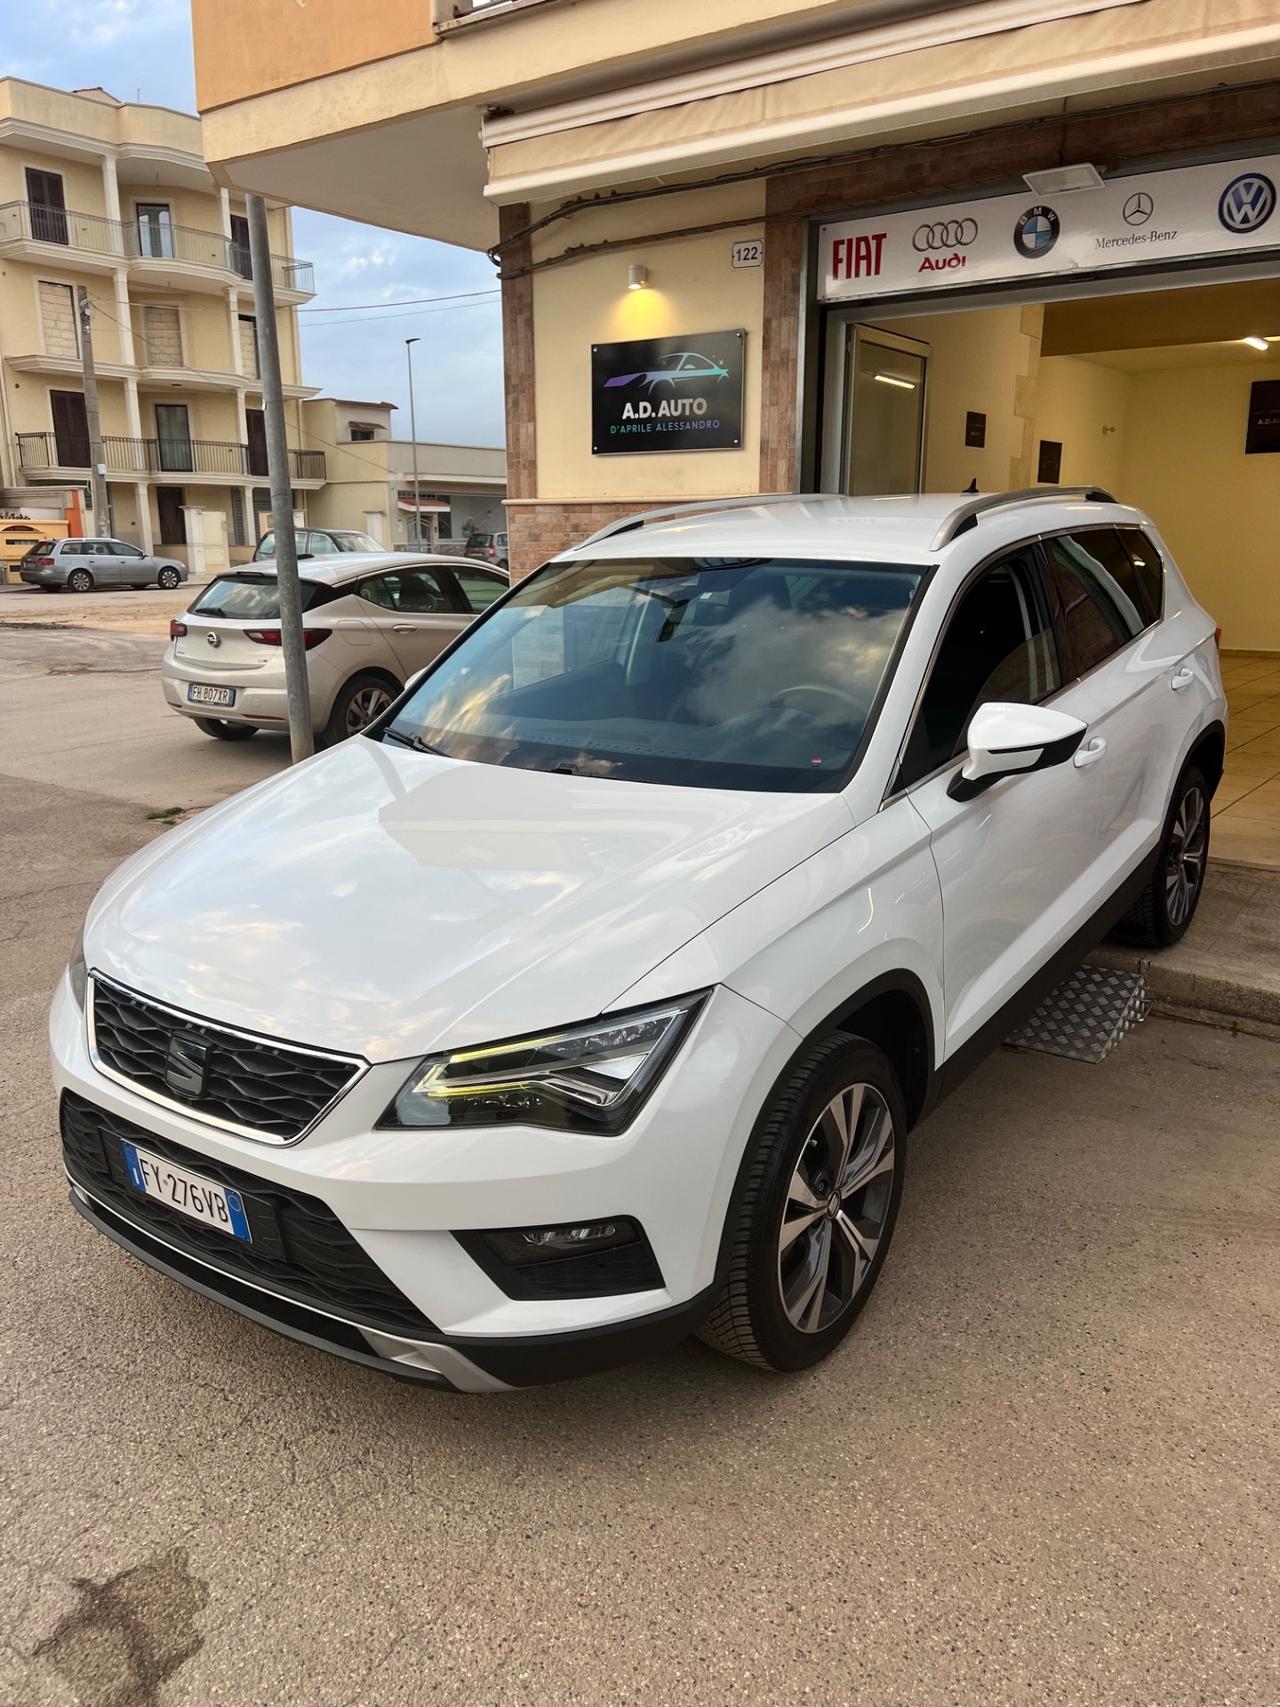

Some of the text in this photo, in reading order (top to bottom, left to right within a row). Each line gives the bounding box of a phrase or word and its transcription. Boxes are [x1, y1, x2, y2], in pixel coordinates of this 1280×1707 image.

[1019, 207, 1057, 226] BMW
[1095, 230, 1179, 249] Mercedes-Benz
[736, 247, 758, 261] 122
[832, 232, 888, 280] FIAT
[918, 252, 967, 273] Audi
[610, 419, 721, 435] D'APRILE ALESSANDRO
[139, 1157, 229, 1223] FY 276VB
